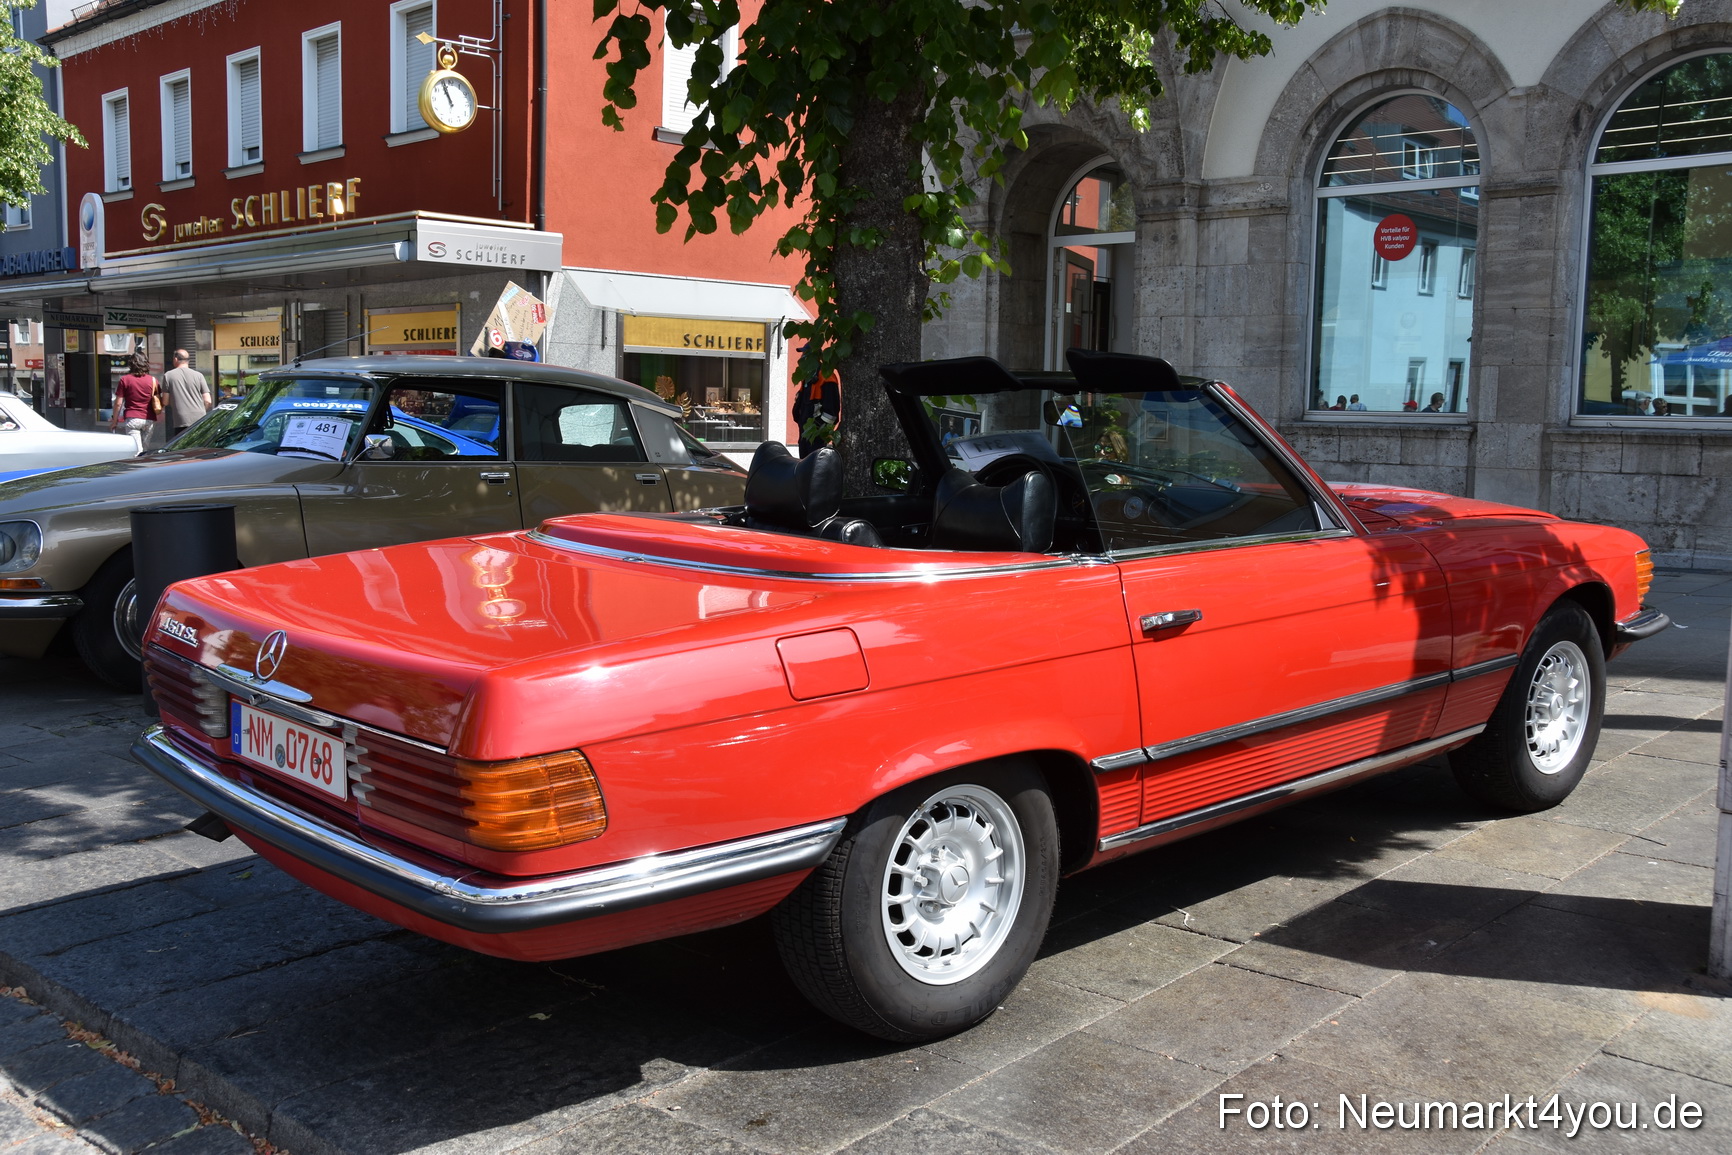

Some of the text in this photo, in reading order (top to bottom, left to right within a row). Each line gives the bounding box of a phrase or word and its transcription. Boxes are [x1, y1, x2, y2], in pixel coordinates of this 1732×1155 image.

[173, 216, 224, 242] juwelier
[231, 178, 361, 230] SCHLIERF
[0, 248, 71, 275] ABAKWAREN
[456, 249, 526, 265] SCHLIERF
[107, 311, 128, 321] NZ
[240, 335, 281, 348] SCHLIERF
[403, 326, 457, 342] SCHLIERF
[489, 329, 503, 346] 6
[683, 333, 764, 351] SCHLIERF
[293, 402, 363, 410] GOODYEAR
[315, 423, 338, 434] 481
[234, 733, 240, 745] D
[249, 713, 333, 785] NM 0768
